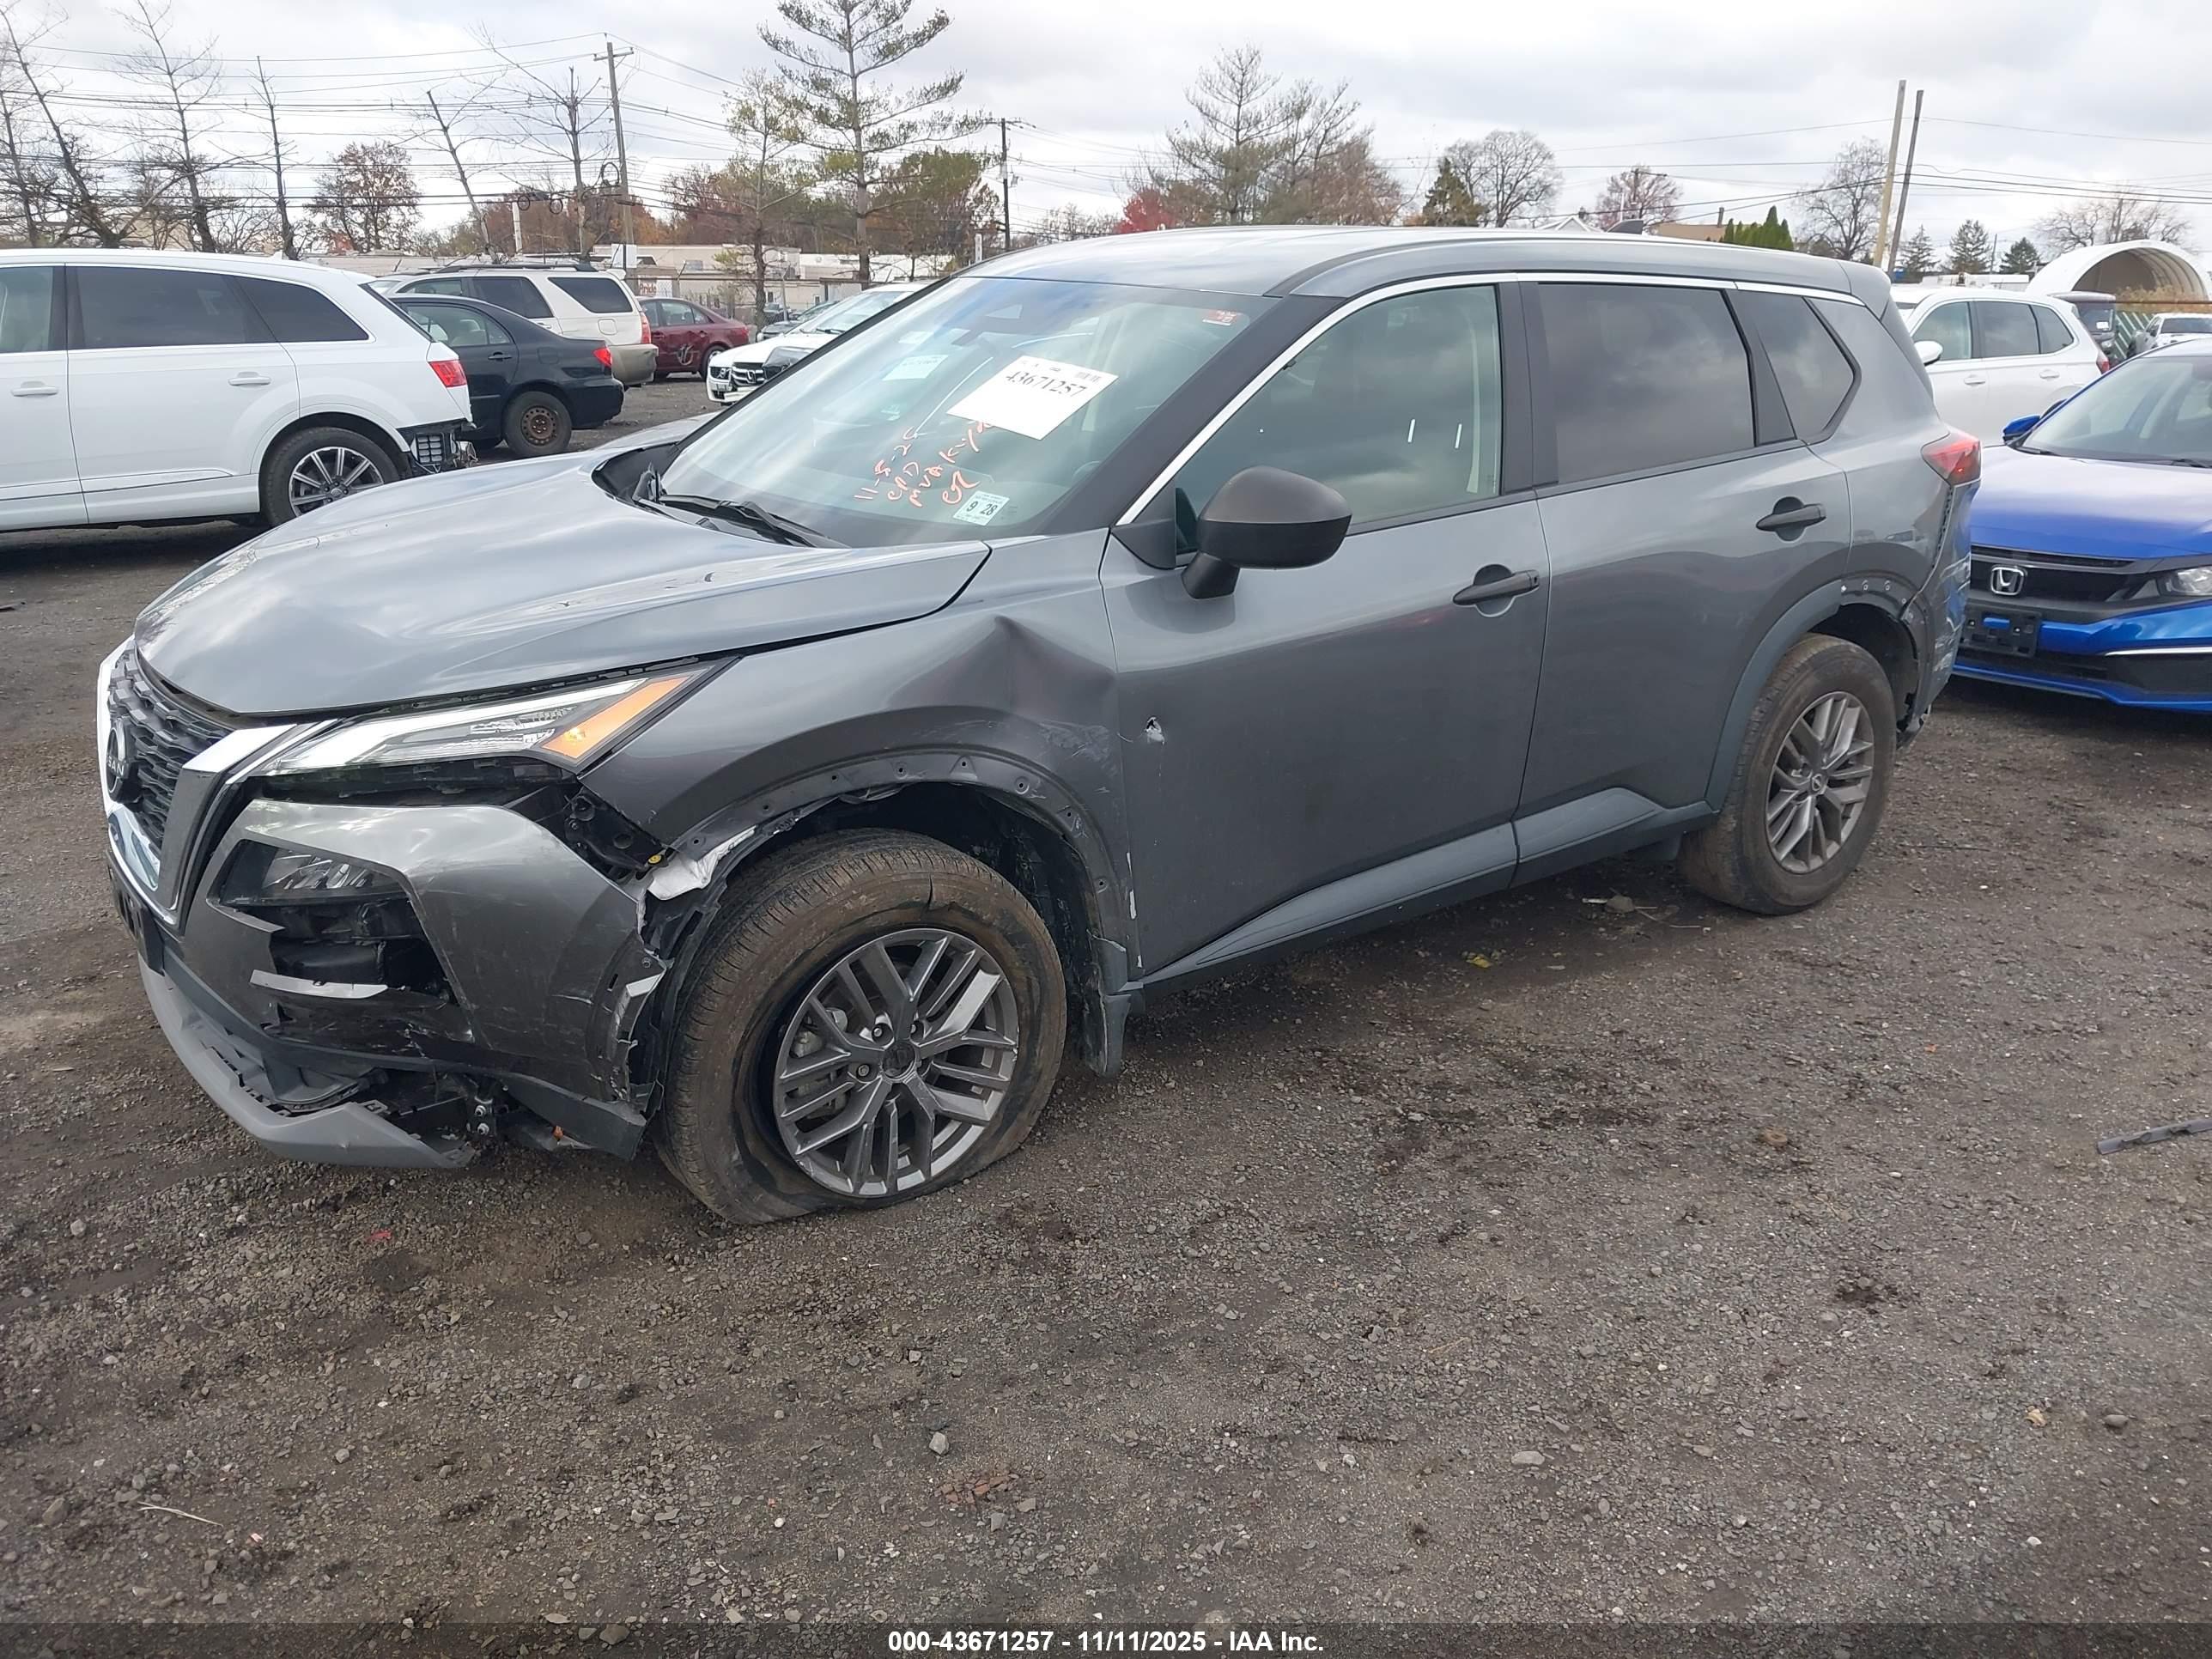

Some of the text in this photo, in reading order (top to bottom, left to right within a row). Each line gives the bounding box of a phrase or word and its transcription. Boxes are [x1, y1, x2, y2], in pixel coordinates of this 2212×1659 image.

[1006, 371, 1088, 397] 43671257
[967, 501, 998, 516] 9 28
